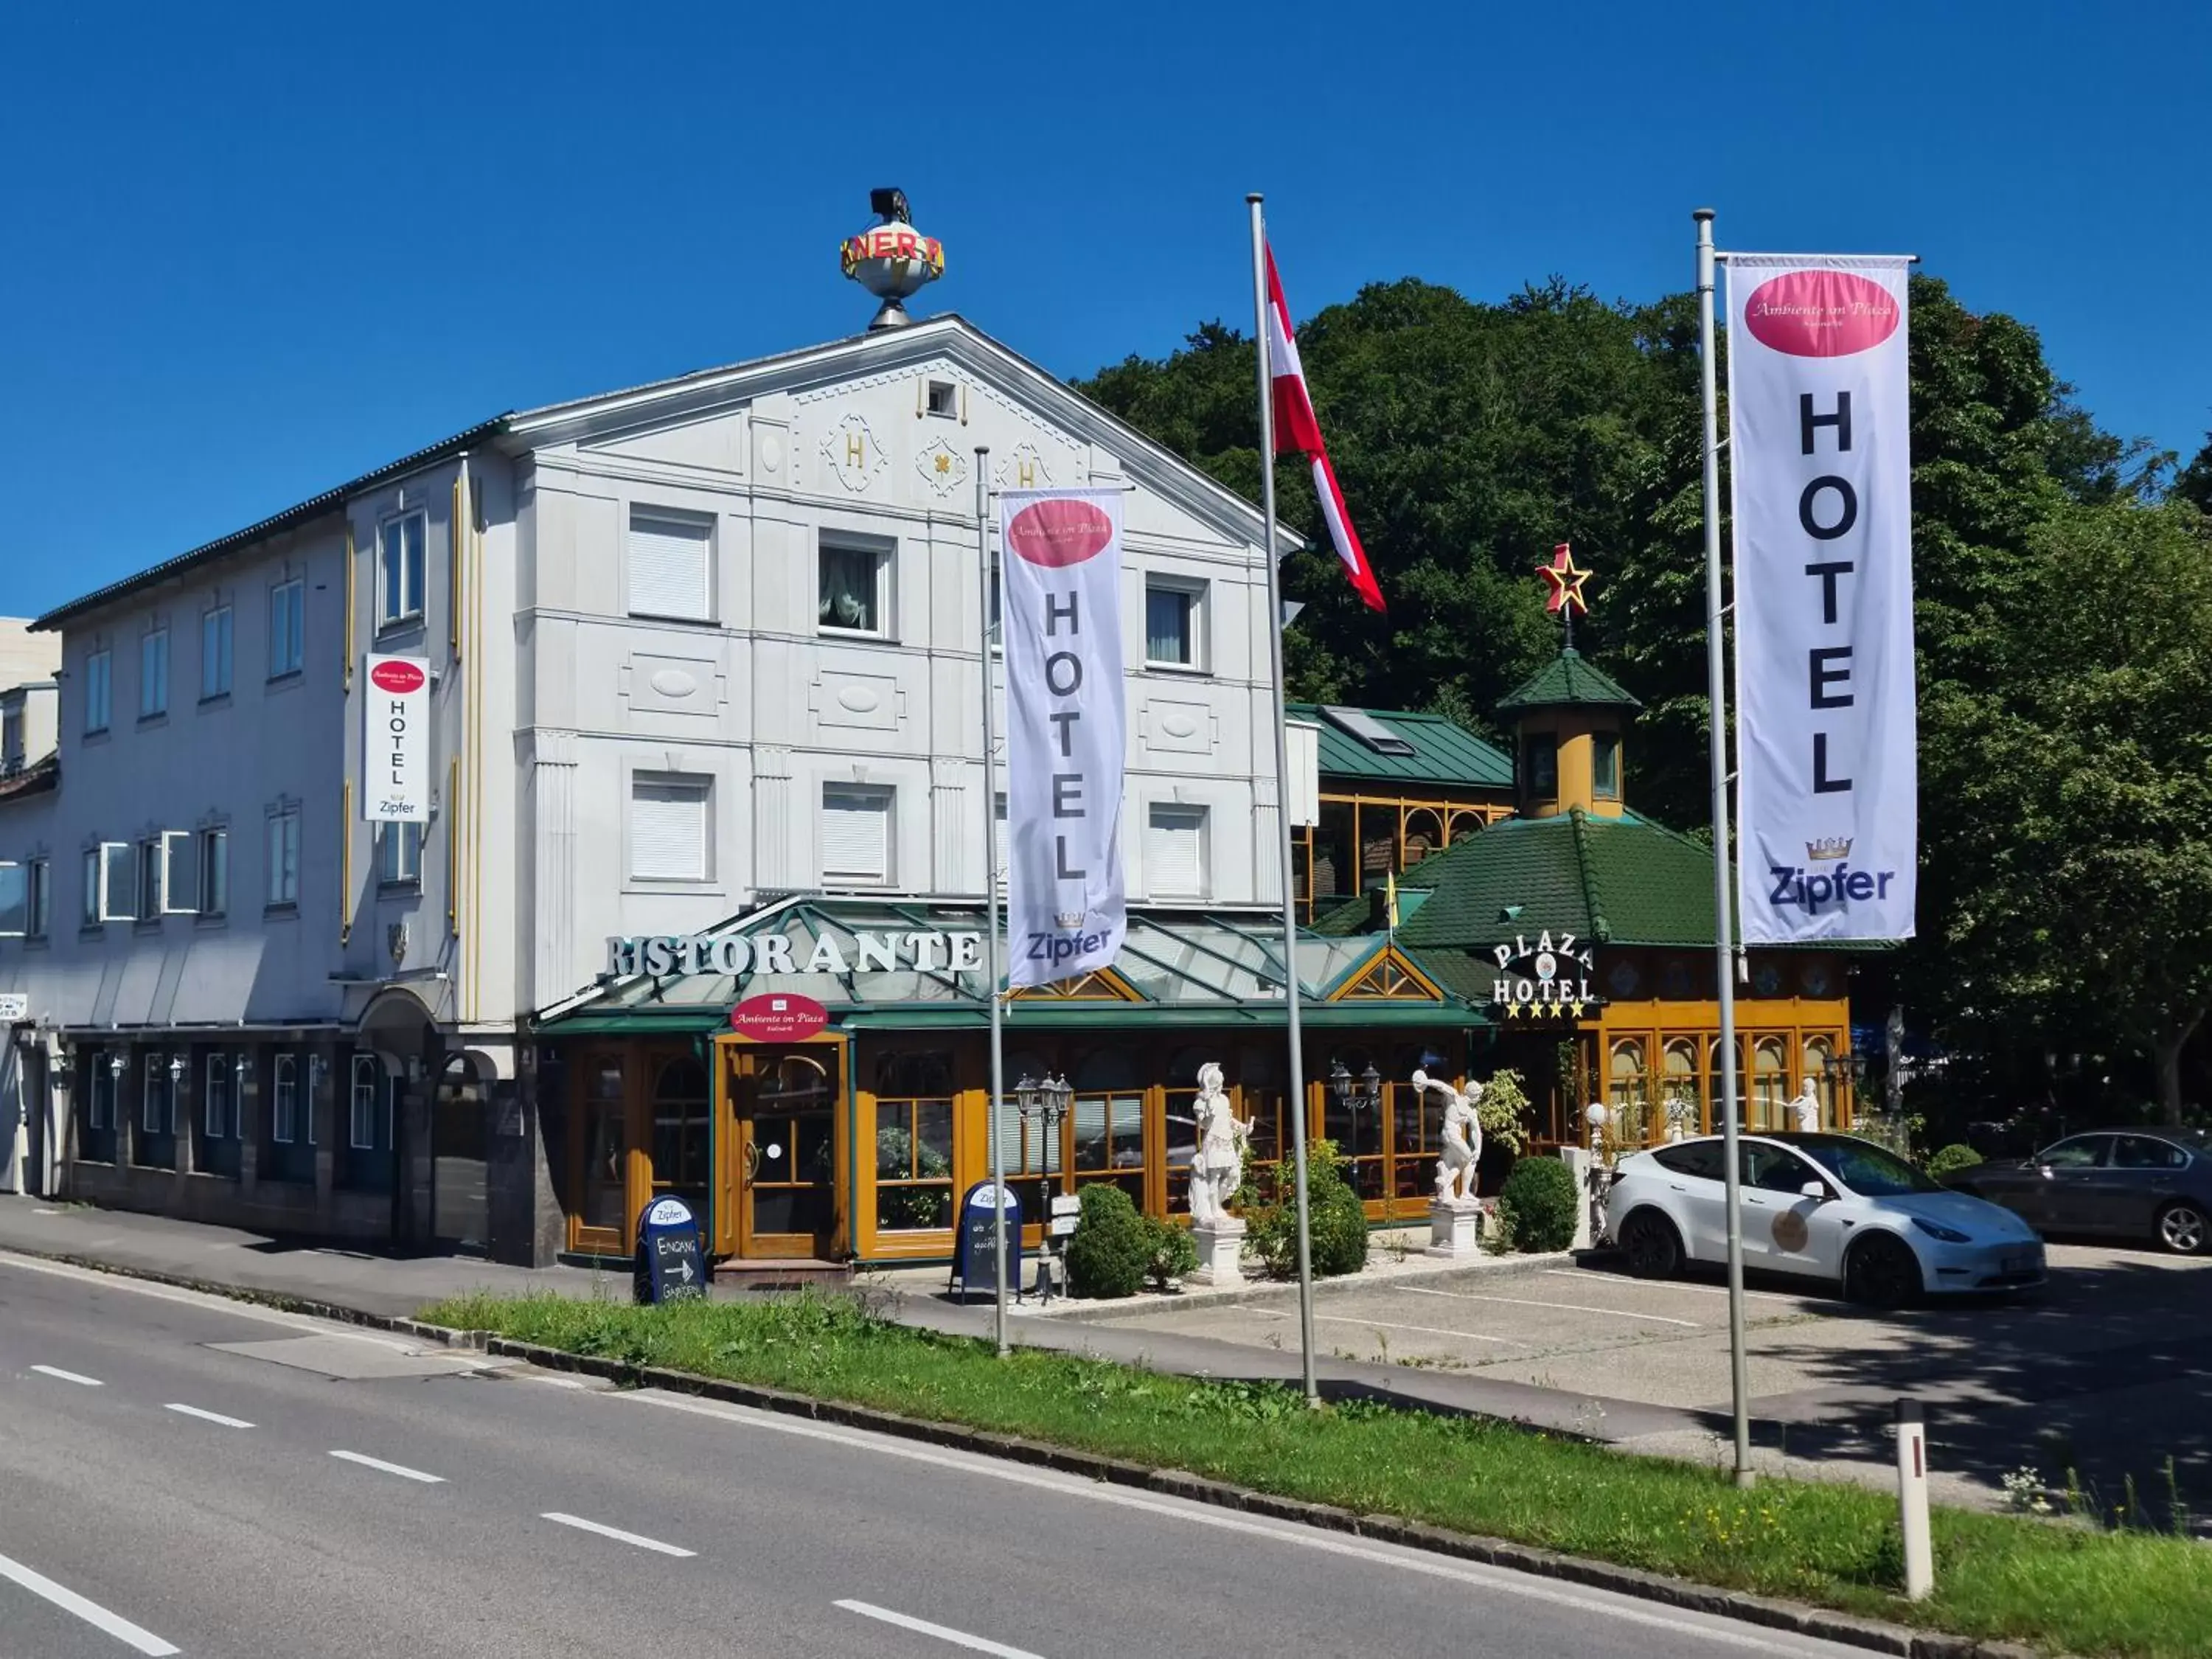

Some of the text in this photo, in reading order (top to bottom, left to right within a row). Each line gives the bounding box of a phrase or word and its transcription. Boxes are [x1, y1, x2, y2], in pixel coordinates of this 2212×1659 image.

[1752, 302, 1823, 317] Ambiente
[1848, 301, 1892, 317] Plaza
[846, 433, 863, 469] H
[1799, 392, 1857, 795] HOTEL
[390, 700, 406, 785] HOTEL
[1046, 591, 1086, 881] HOTEL
[380, 799, 415, 816] Zipfer
[1769, 862, 1896, 916] Zipfer
[605, 931, 983, 975] RISTORANTE
[1026, 929, 1112, 968] Zipfer
[1493, 929, 1594, 971] PLAZA
[1493, 978, 1595, 1004] HOTEL
[734, 1013, 781, 1024] Ambiente
[796, 1012, 824, 1023] Plaza
[657, 1209, 683, 1222] Zipfer
